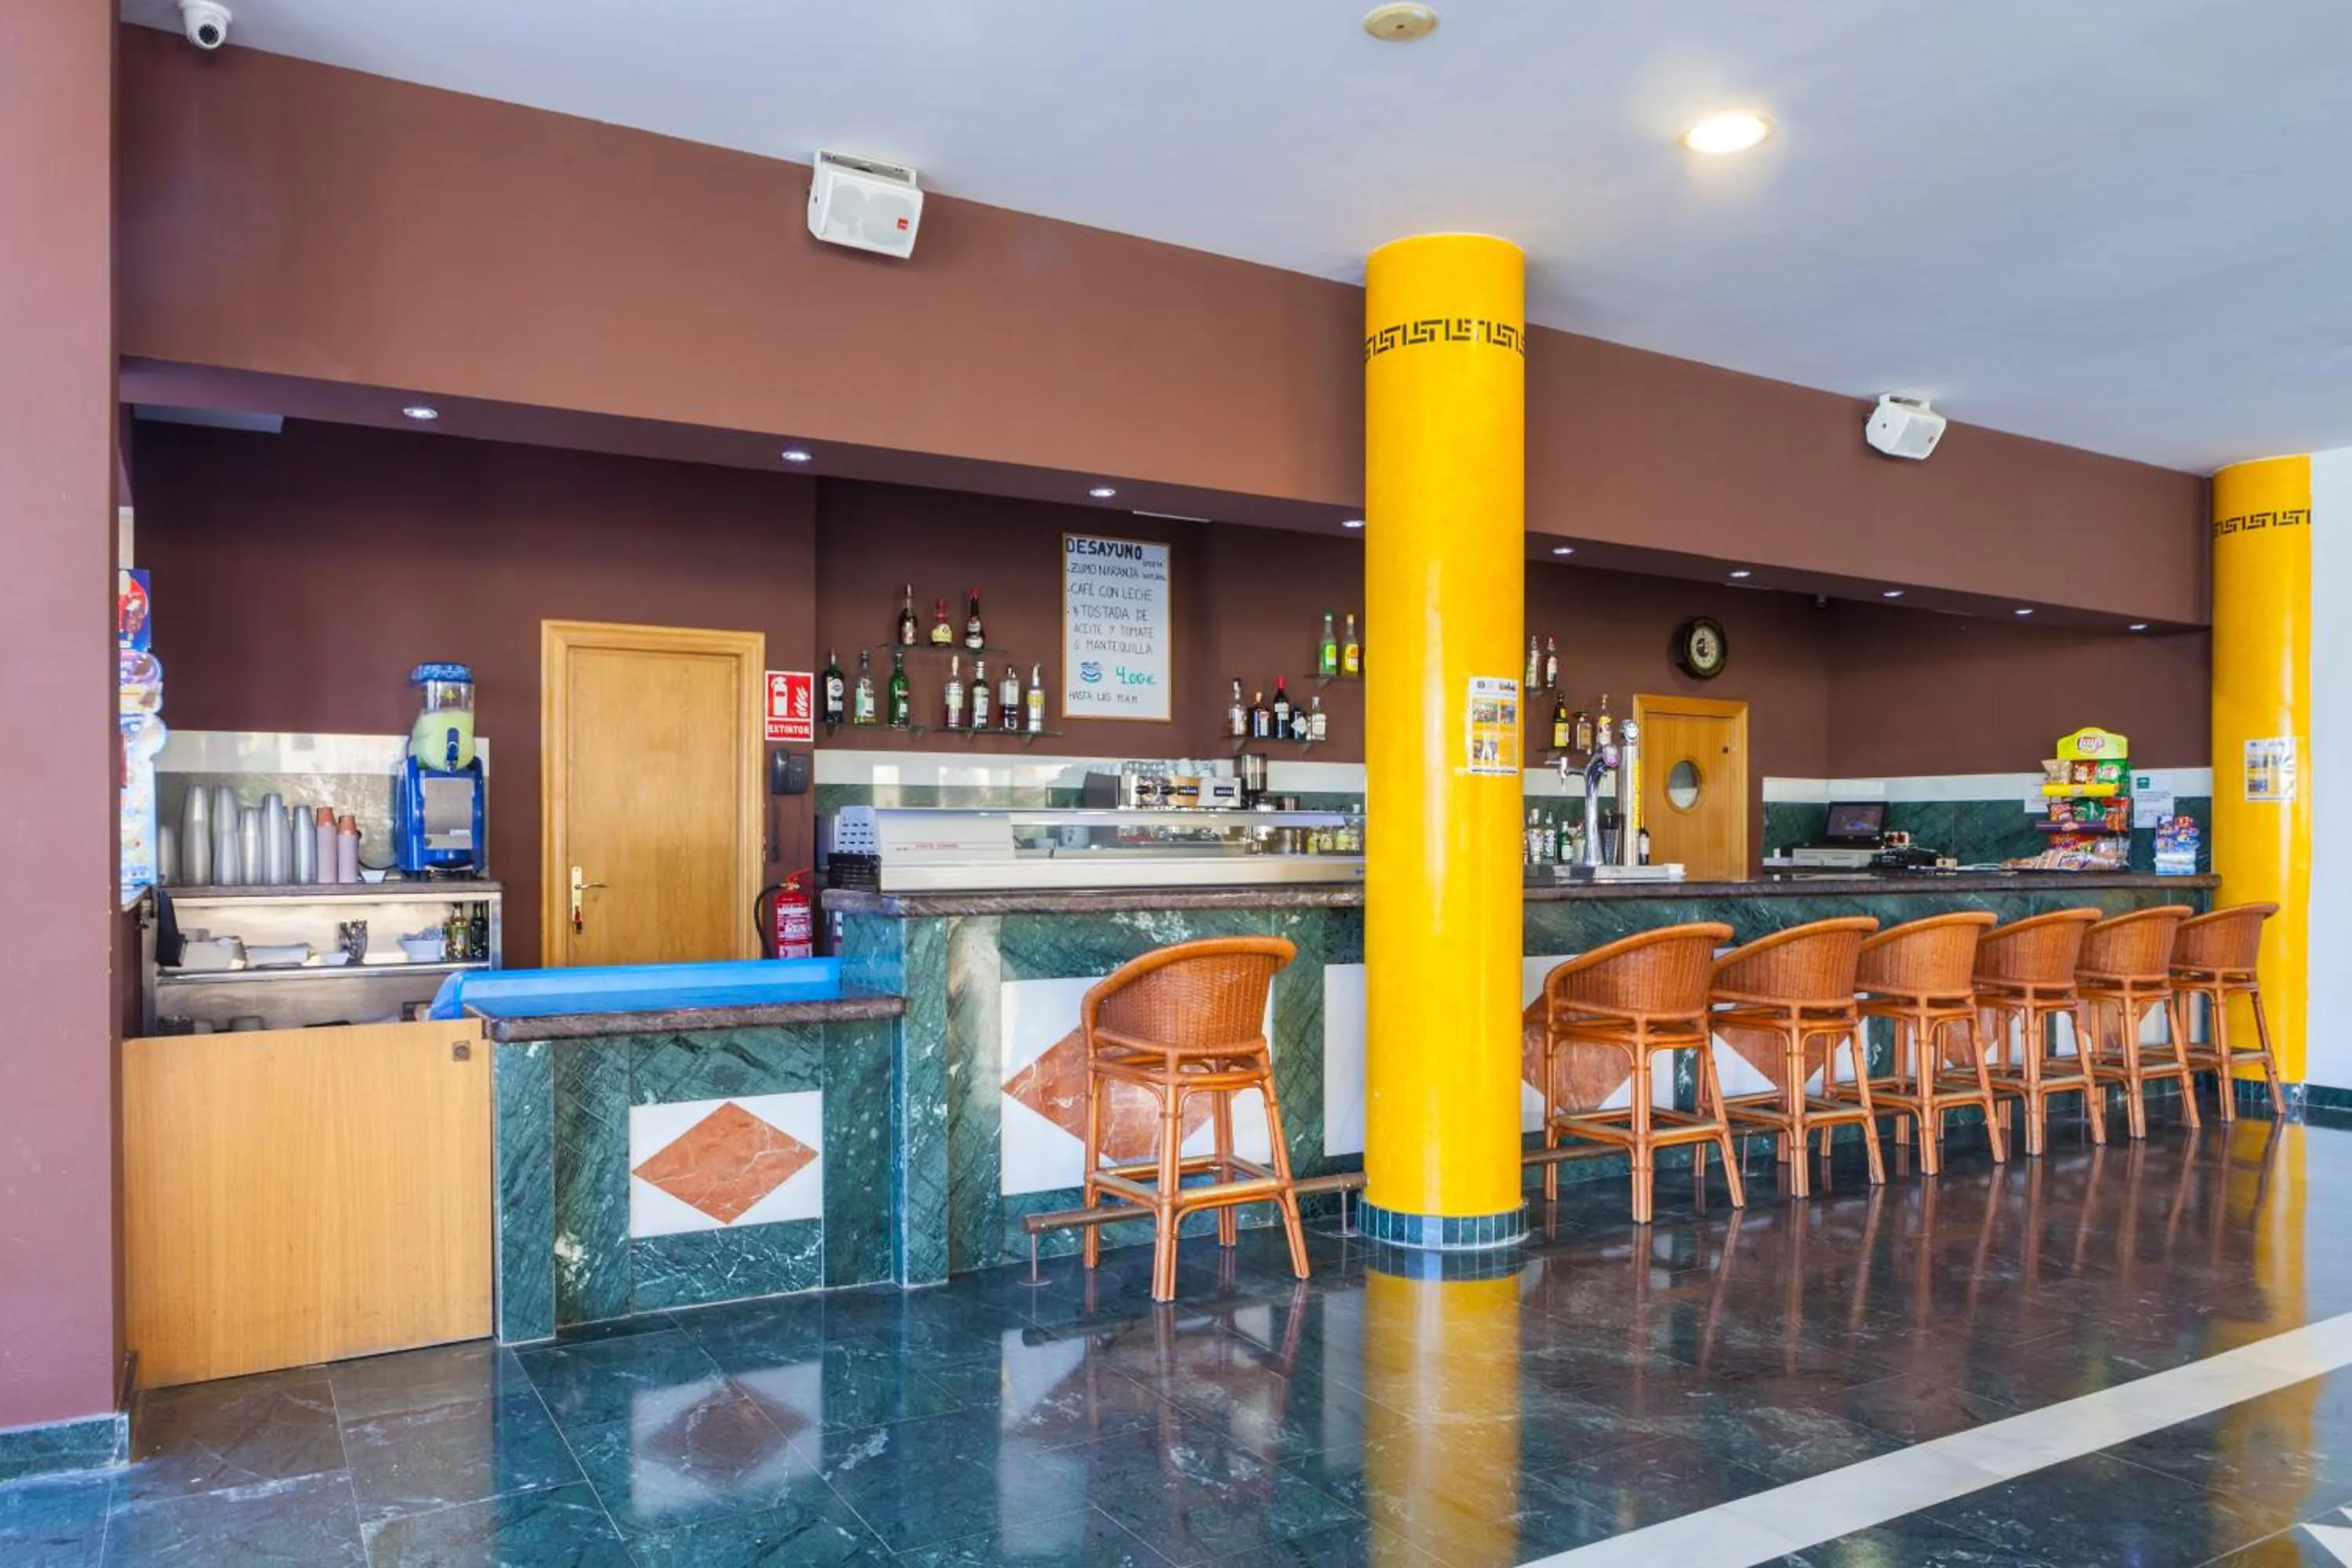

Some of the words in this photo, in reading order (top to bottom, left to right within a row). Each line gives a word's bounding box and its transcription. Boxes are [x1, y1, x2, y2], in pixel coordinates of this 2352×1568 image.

[1066, 538, 1142, 560] DESAYUNO
[1070, 562, 1096, 575] ZUMO
[1098, 565, 1139, 578] NARANJA
[1098, 586, 1120, 599] CON
[1122, 587, 1154, 602] LECHE
[1080, 604, 1130, 620] TOSTADA
[1136, 608, 1149, 622] DE
[1073, 623, 1102, 636] ACEITE
[1109, 625, 1116, 635] Y
[1121, 625, 1155, 639] TOMATE
[1086, 640, 1153, 656] MANTEQUILLA
[1069, 691, 1092, 702] HASTA
[768, 724, 810, 735] EXTINTOR
